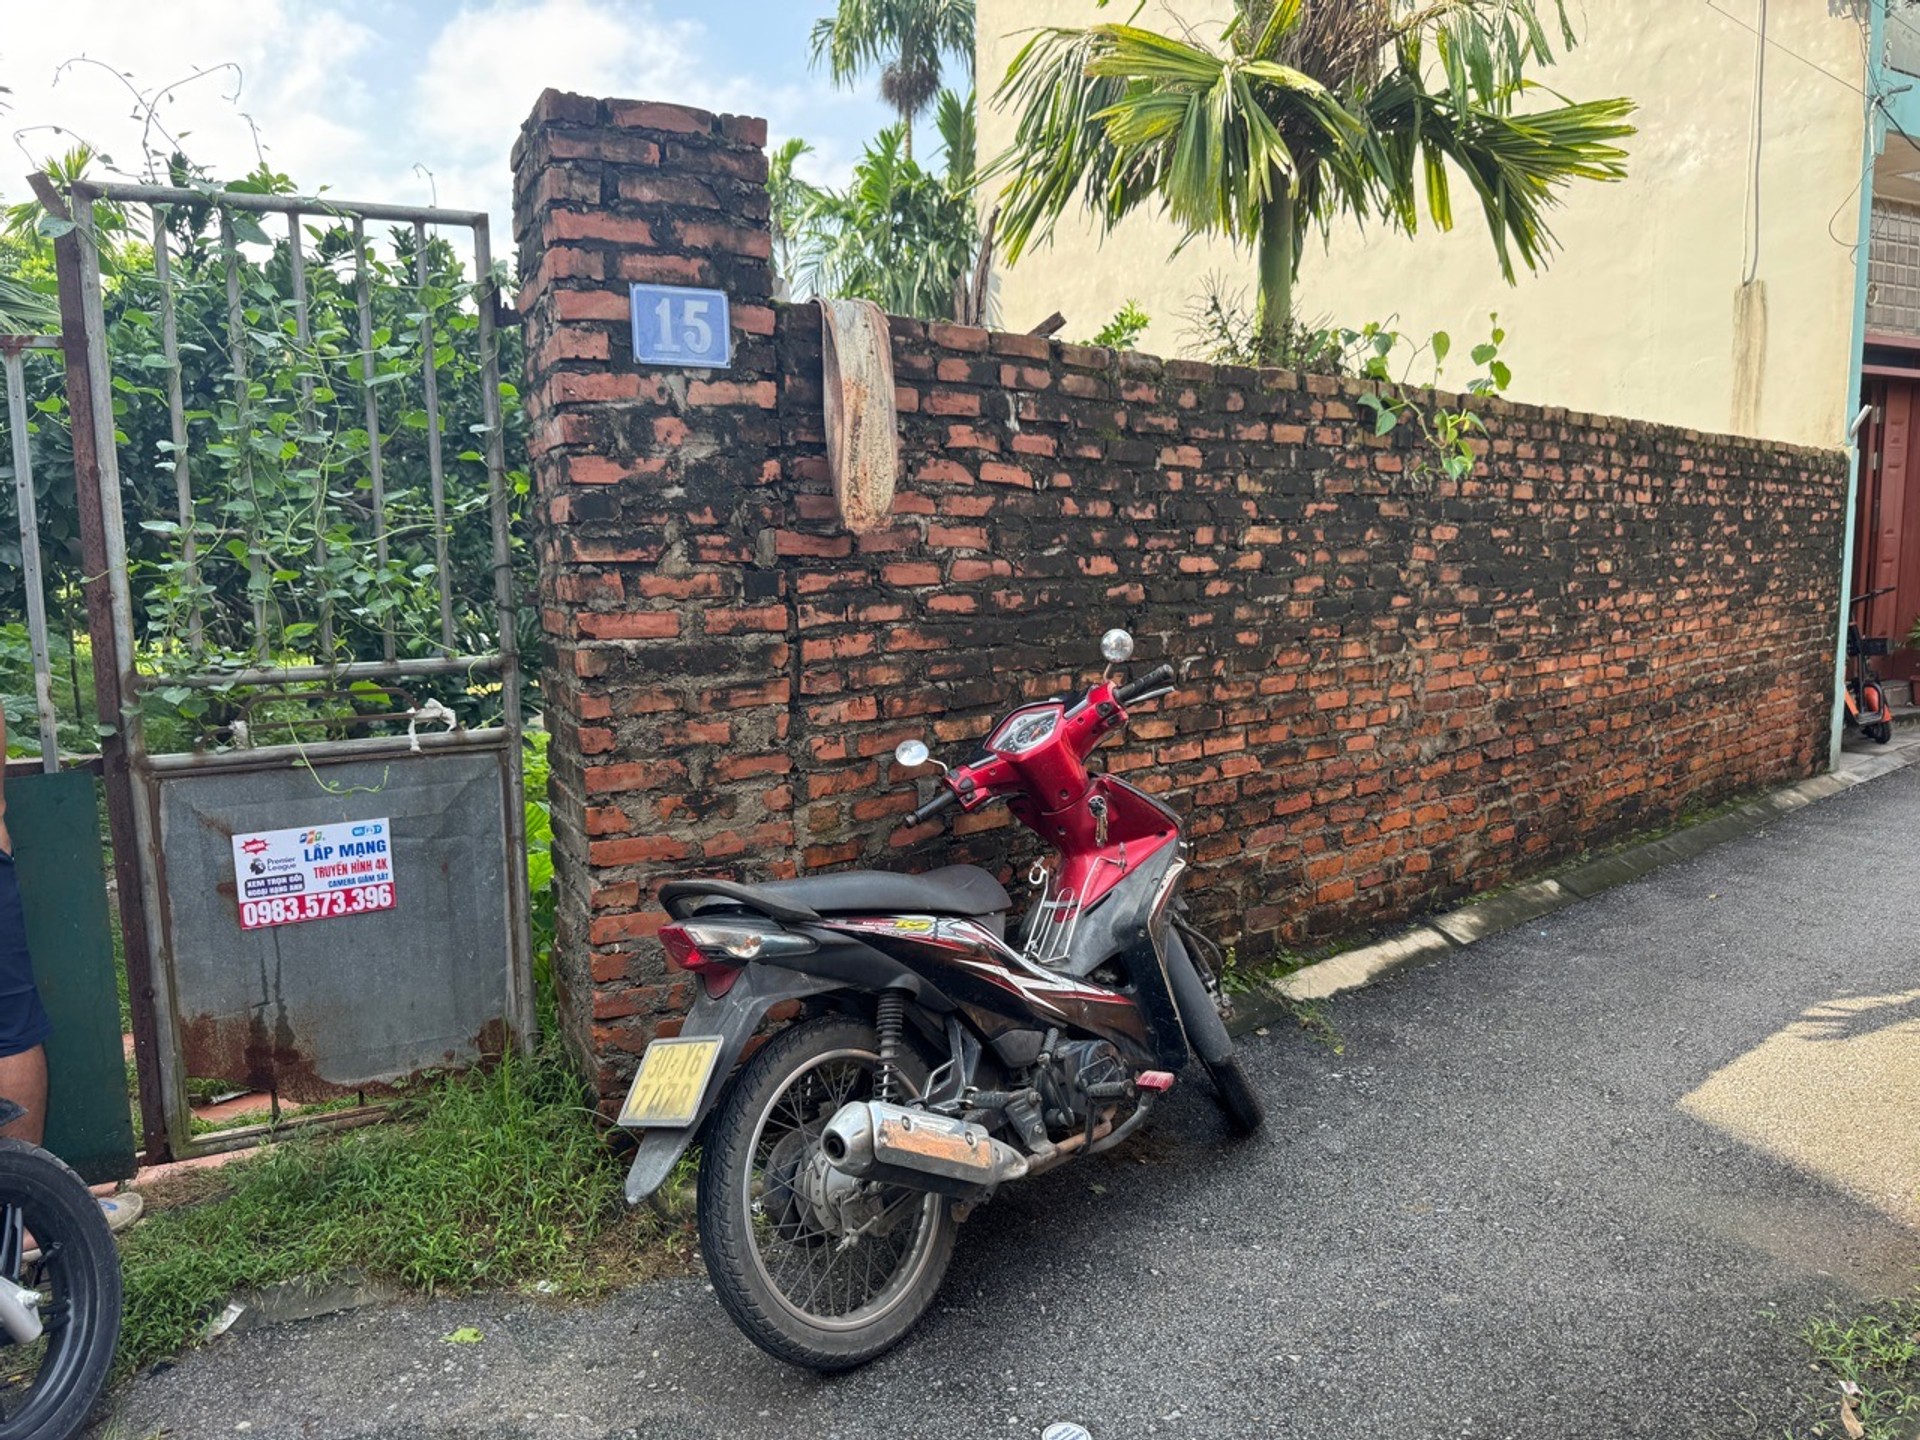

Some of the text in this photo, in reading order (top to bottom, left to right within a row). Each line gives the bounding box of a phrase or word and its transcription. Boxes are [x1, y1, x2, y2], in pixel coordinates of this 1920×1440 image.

[653, 298, 712, 353] 15
[339, 839, 386, 858] MẠNG
[267, 857, 296, 865] Premier
[375, 858, 388, 870] 4K
[267, 863, 297, 872] League
[328, 877, 356, 888] CAMERA
[242, 885, 392, 926] 0983.573.396
